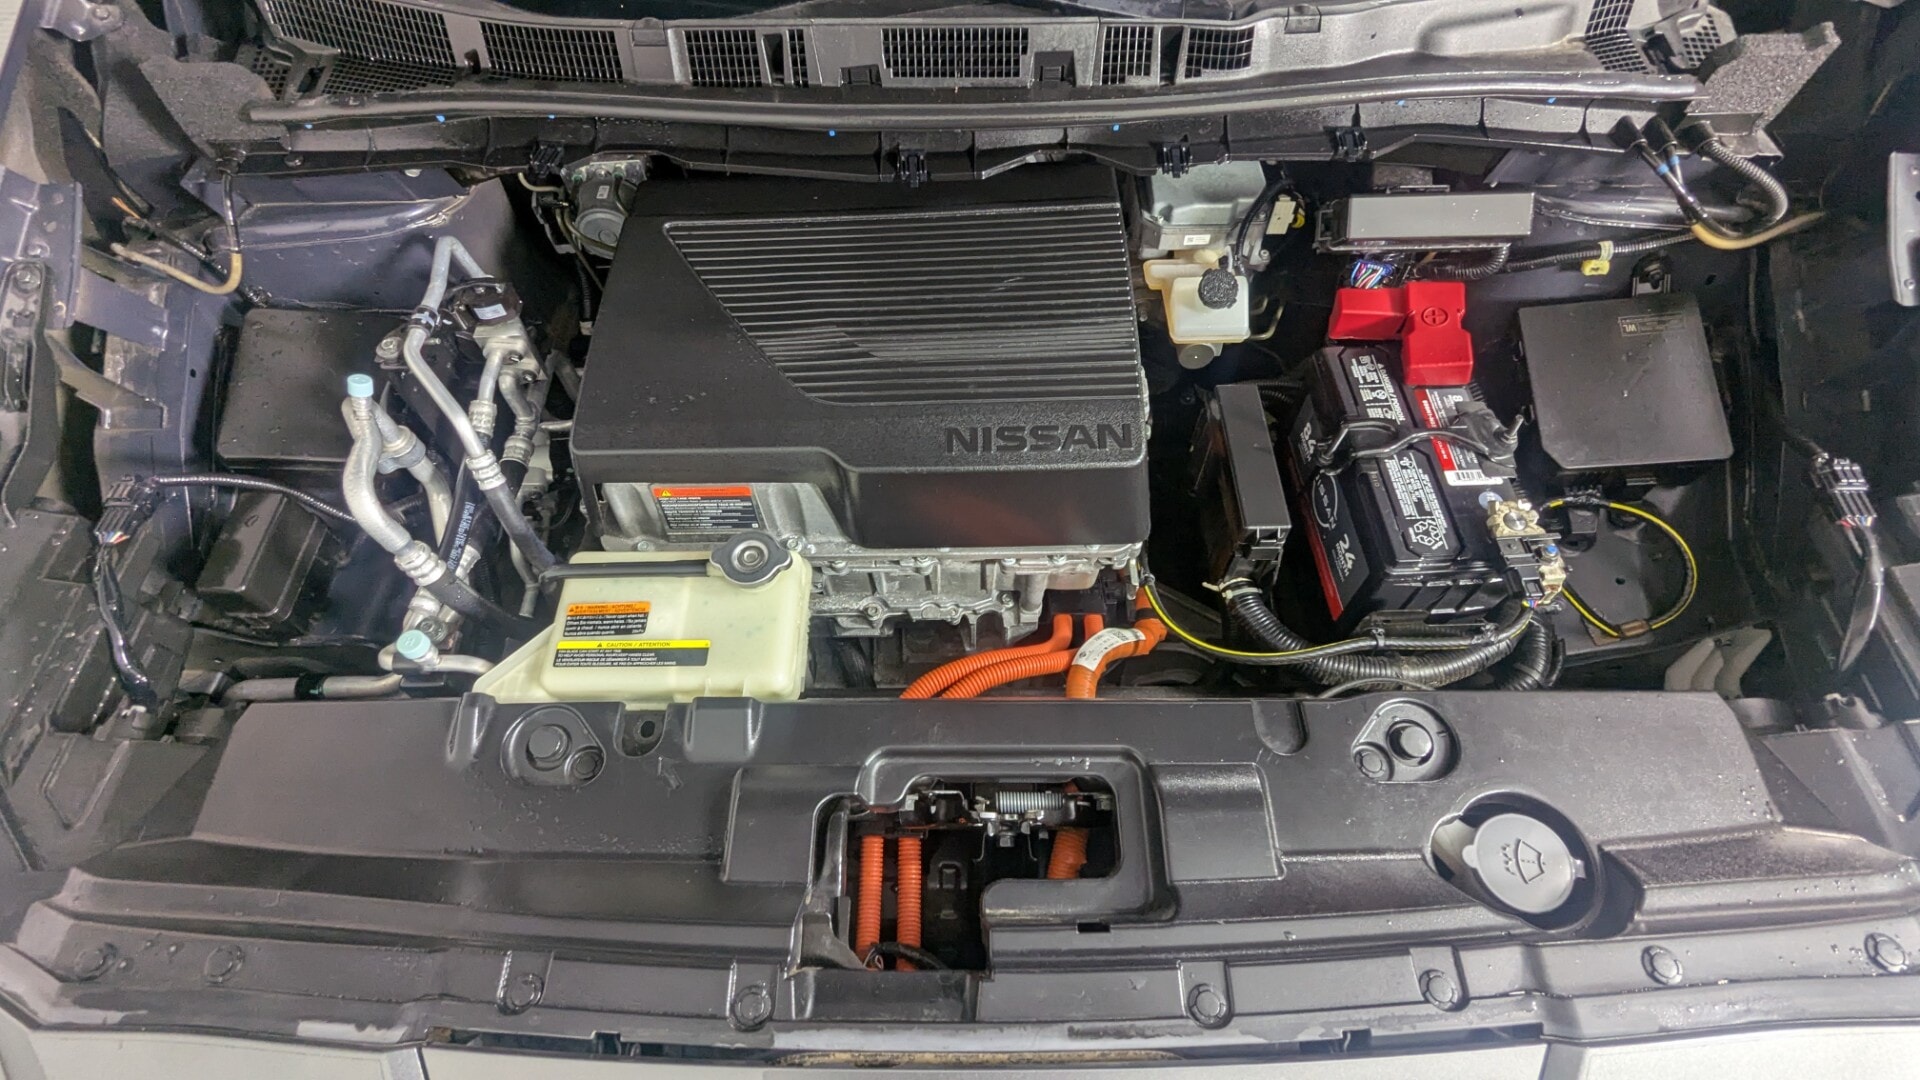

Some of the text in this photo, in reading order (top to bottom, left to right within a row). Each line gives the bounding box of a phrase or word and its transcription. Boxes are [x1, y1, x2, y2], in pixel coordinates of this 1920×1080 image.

[1380, 369, 1394, 393] DANGER
[1391, 398, 1406, 421] POISON
[946, 423, 1133, 453] NISSAN
[1335, 543, 1350, 577] MONTH
[1339, 533, 1356, 569] 24
